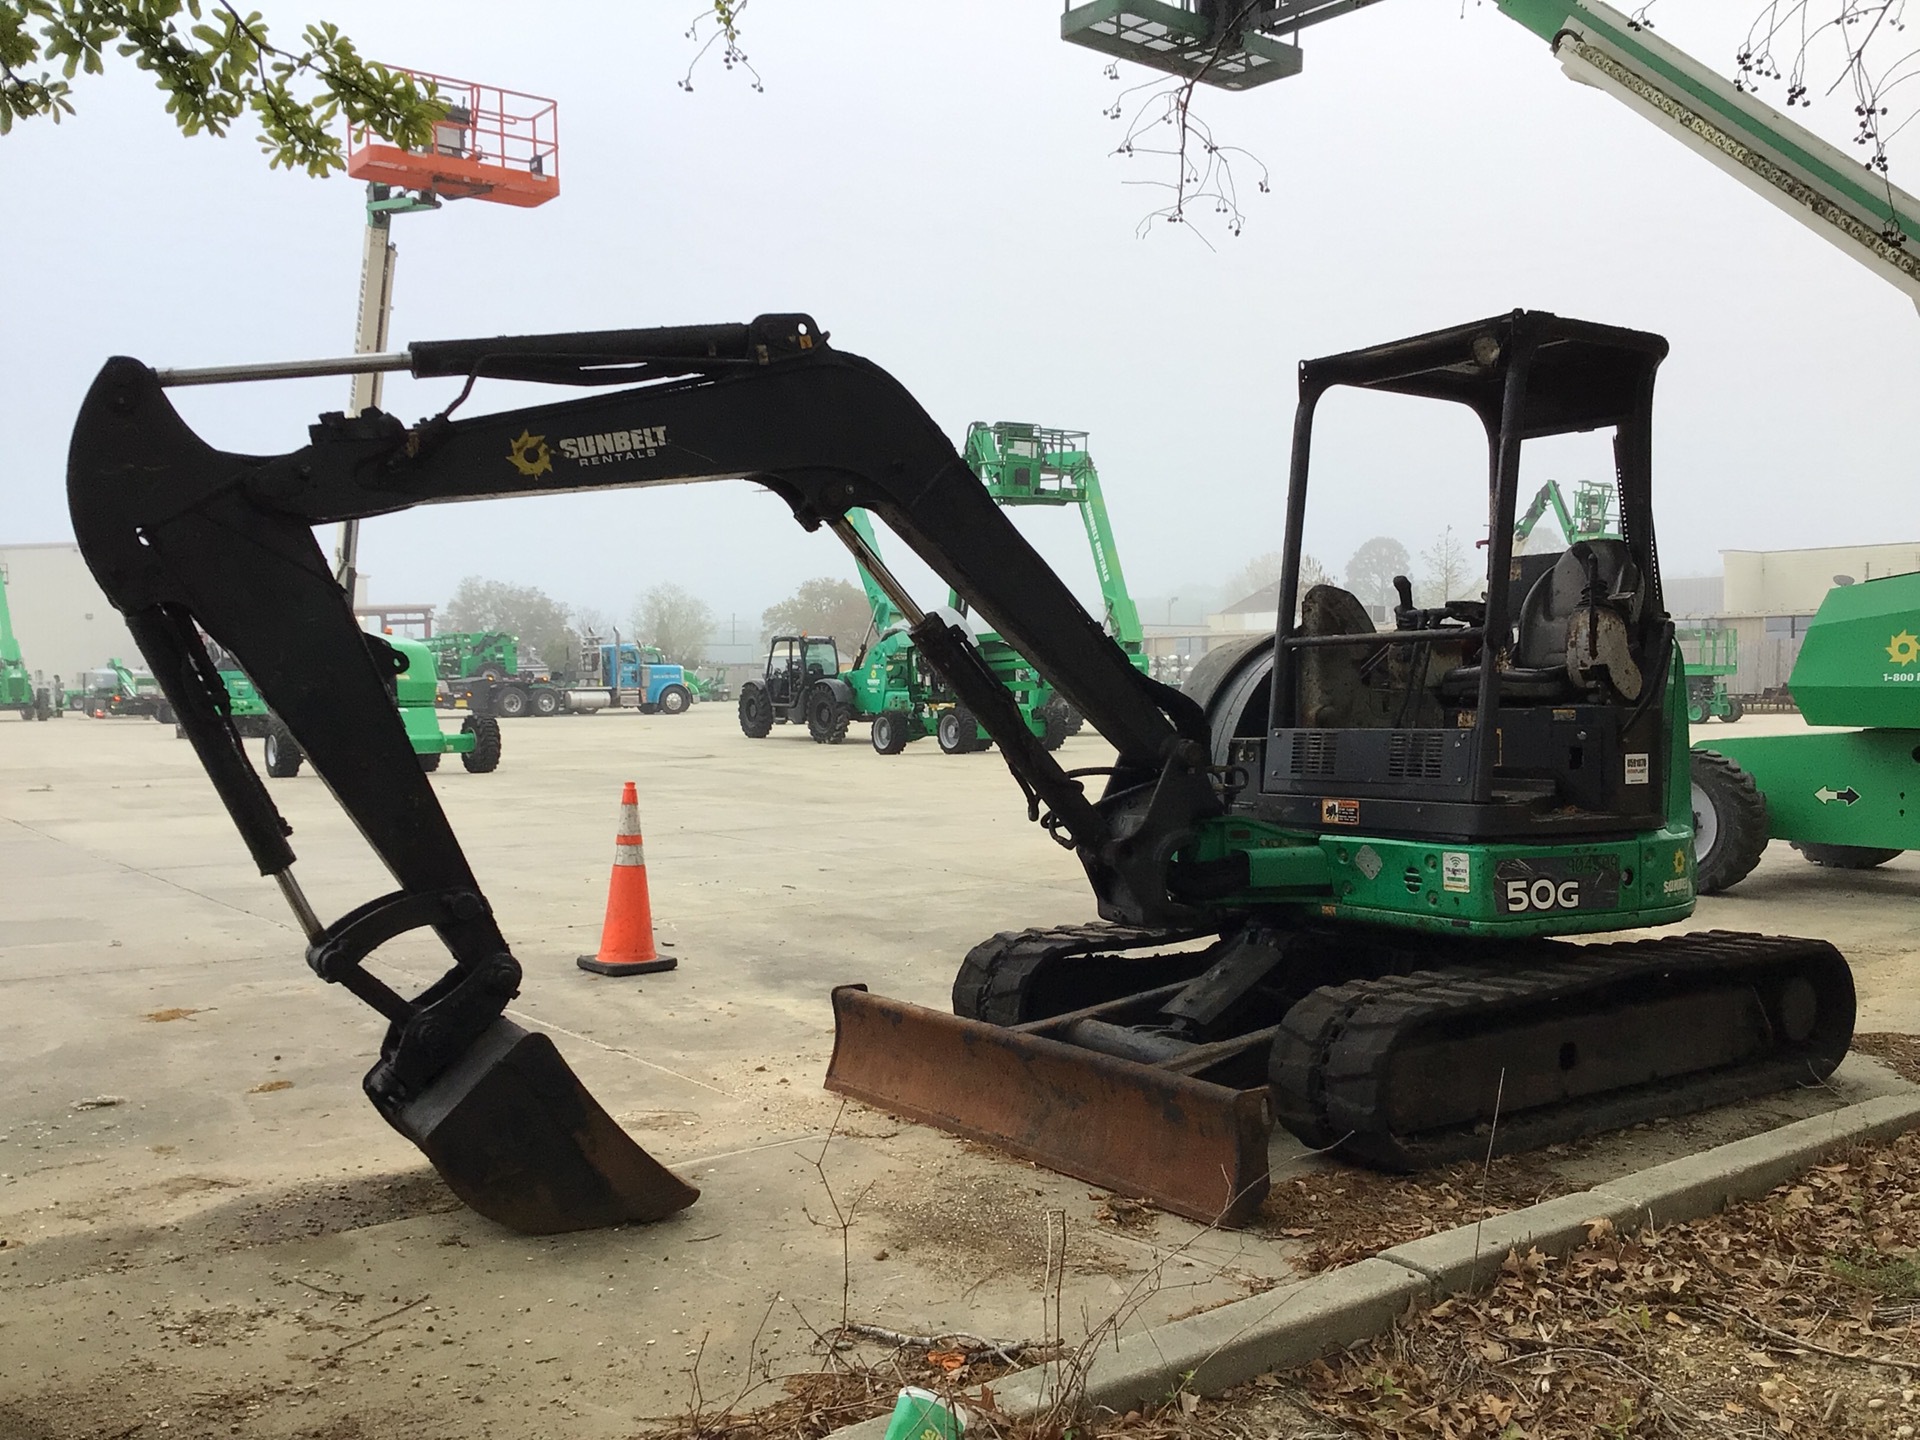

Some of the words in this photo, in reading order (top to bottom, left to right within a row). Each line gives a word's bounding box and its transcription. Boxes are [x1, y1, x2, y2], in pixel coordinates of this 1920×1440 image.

[559, 426, 667, 459] SUNBELT
[579, 449, 657, 467] RENTALS
[1085, 501, 1099, 541] SUNBELT
[1095, 541, 1110, 583] RENTALS
[1883, 673, 1914, 682] 1-800
[1507, 879, 1579, 912] 50G
